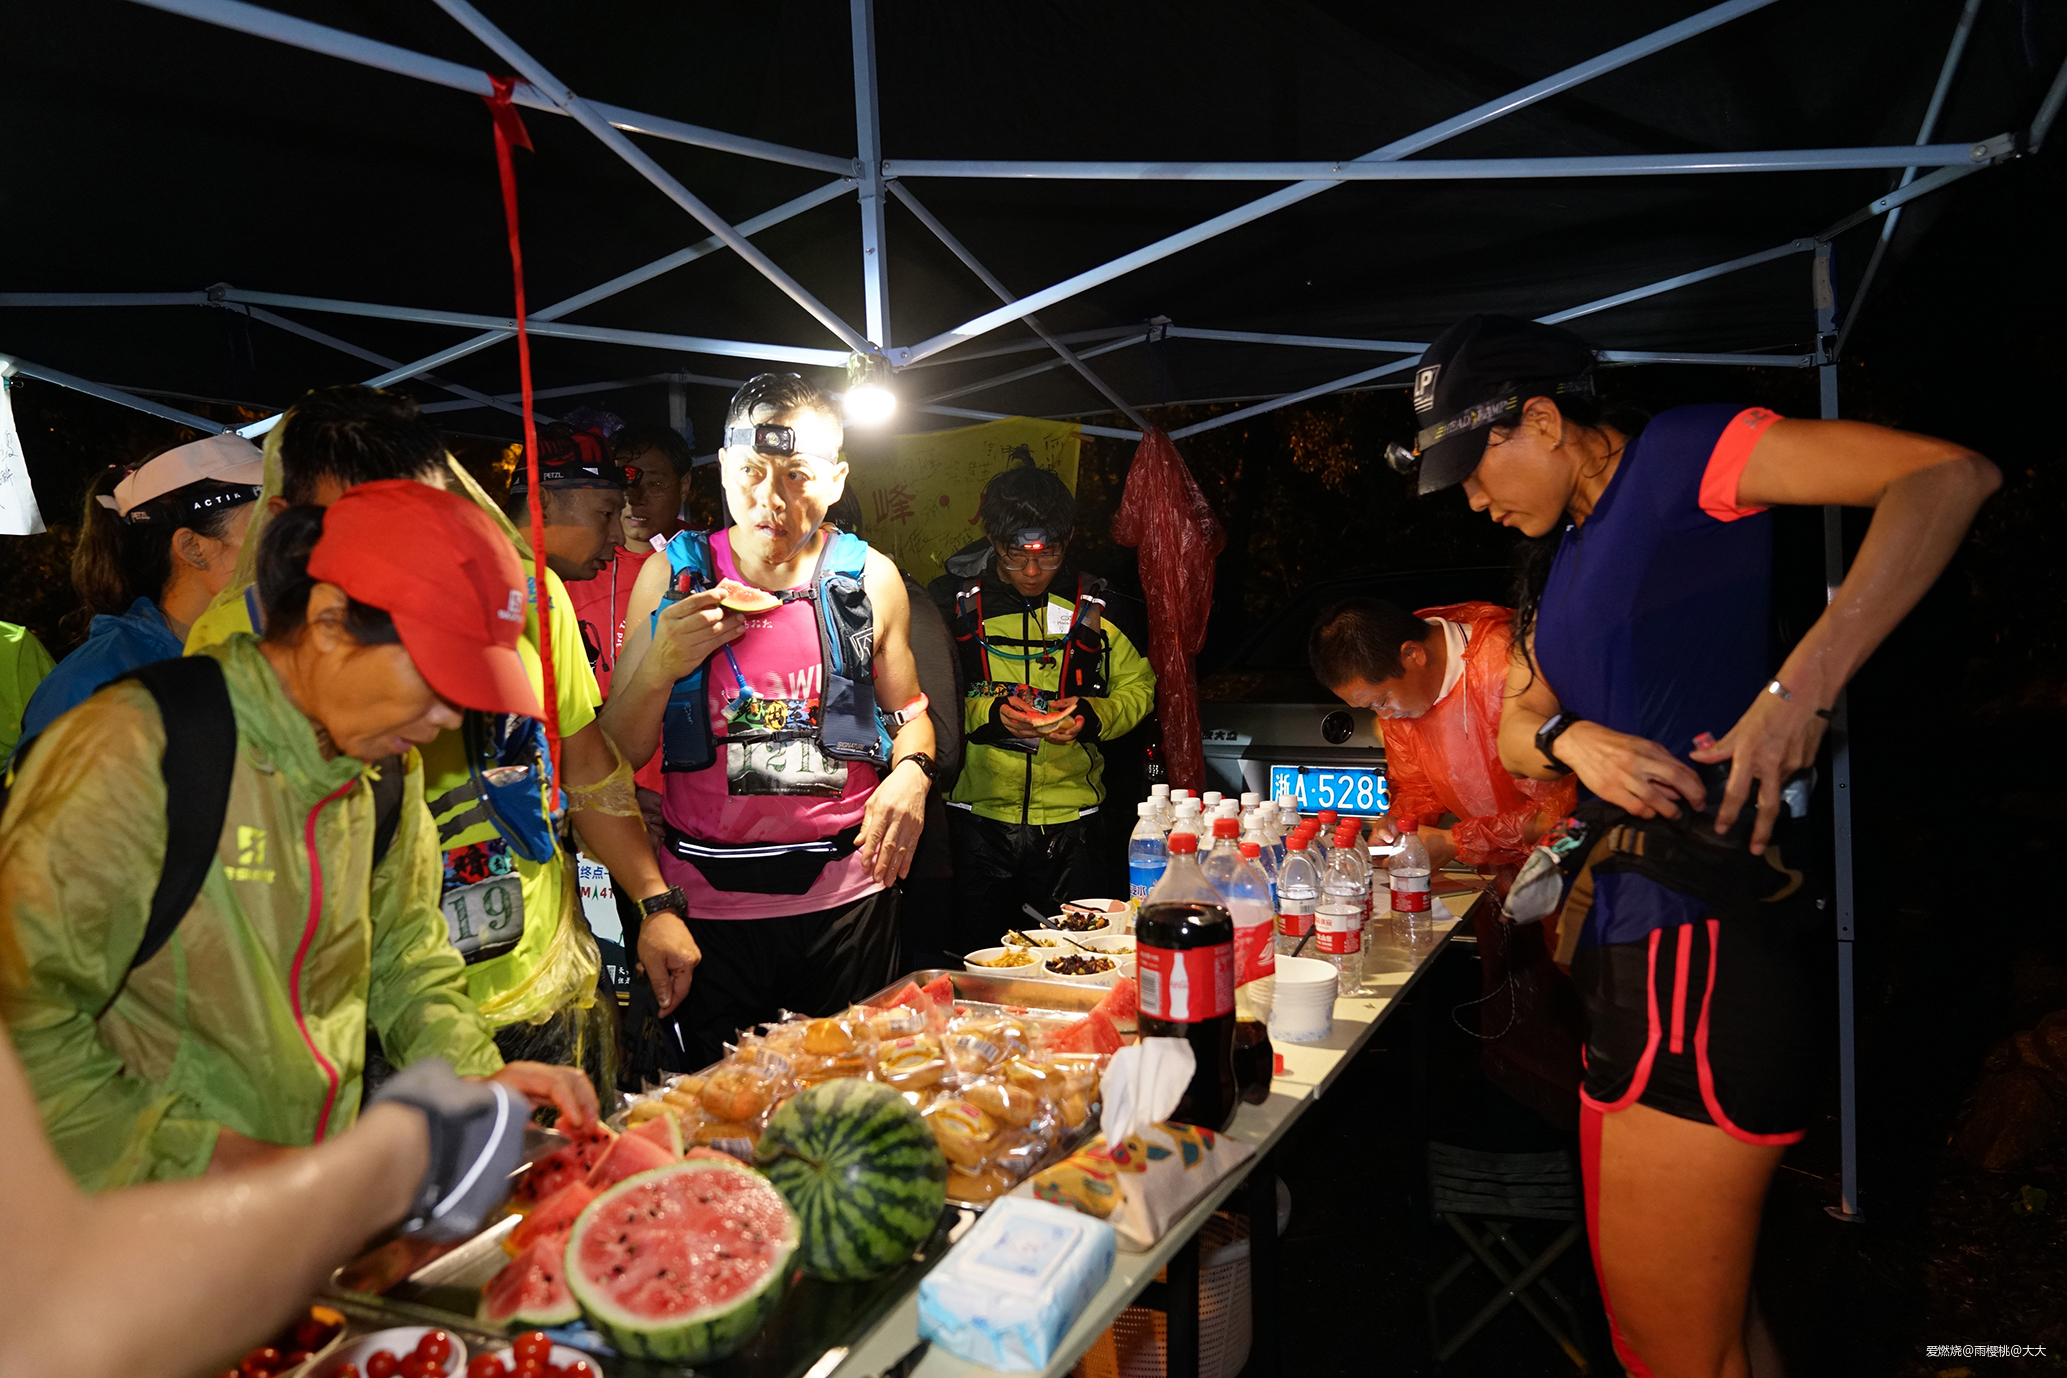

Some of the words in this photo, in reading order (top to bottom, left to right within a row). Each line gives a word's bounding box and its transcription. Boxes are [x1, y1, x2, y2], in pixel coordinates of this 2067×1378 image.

[1443, 415, 1470, 435] HEAD
[543, 471, 564, 481] PETZL
[194, 492, 241, 510] ACTIK
[872, 484, 916, 527] 峰
